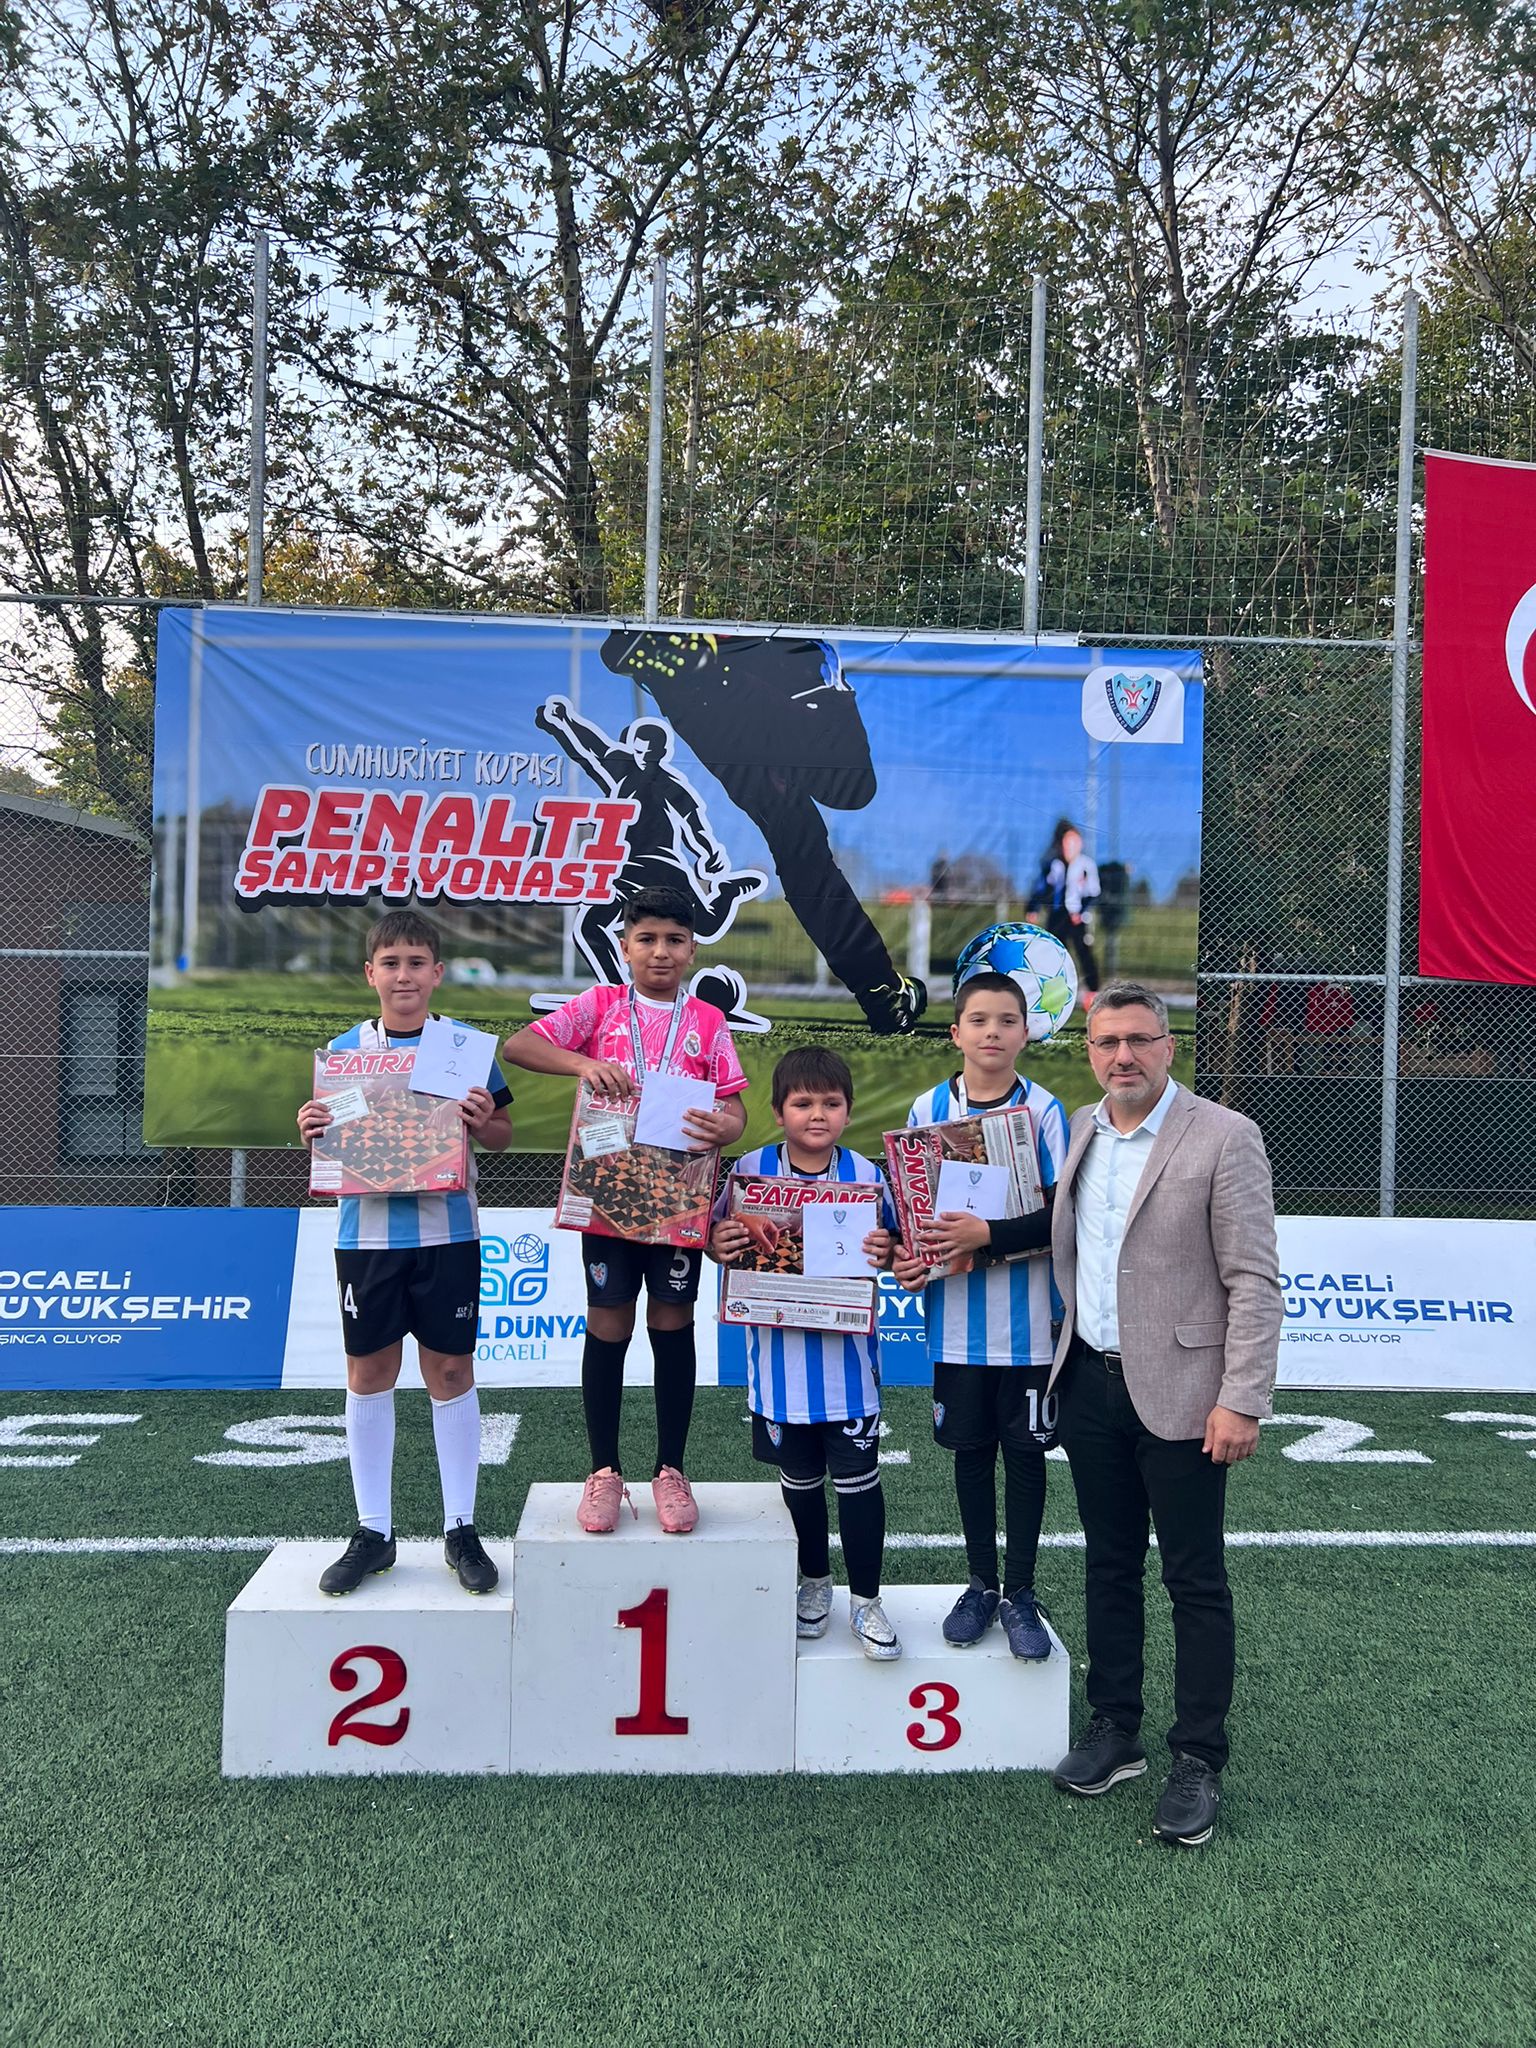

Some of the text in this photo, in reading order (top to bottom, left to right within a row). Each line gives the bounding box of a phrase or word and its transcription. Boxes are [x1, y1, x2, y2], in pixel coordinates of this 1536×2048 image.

[306, 738, 564, 789] CUMHURİYET KUPASI
[250, 788, 637, 862] PENALTI
[323, 1053, 417, 1077] SATRA
[669, 1247, 690, 1279] 5
[835, 1241, 848, 1256] 3.
[53, 1334, 122, 1344] OLUYOR
[495, 1315, 587, 1339] DÜNYA
[1339, 1333, 1402, 1344] OLUYOR
[474, 1340, 547, 1361] OCAELİ
[1025, 1388, 1060, 1432] 10
[614, 1587, 689, 1736] 1
[327, 1644, 411, 1748] 2
[905, 1681, 963, 1752] 3
